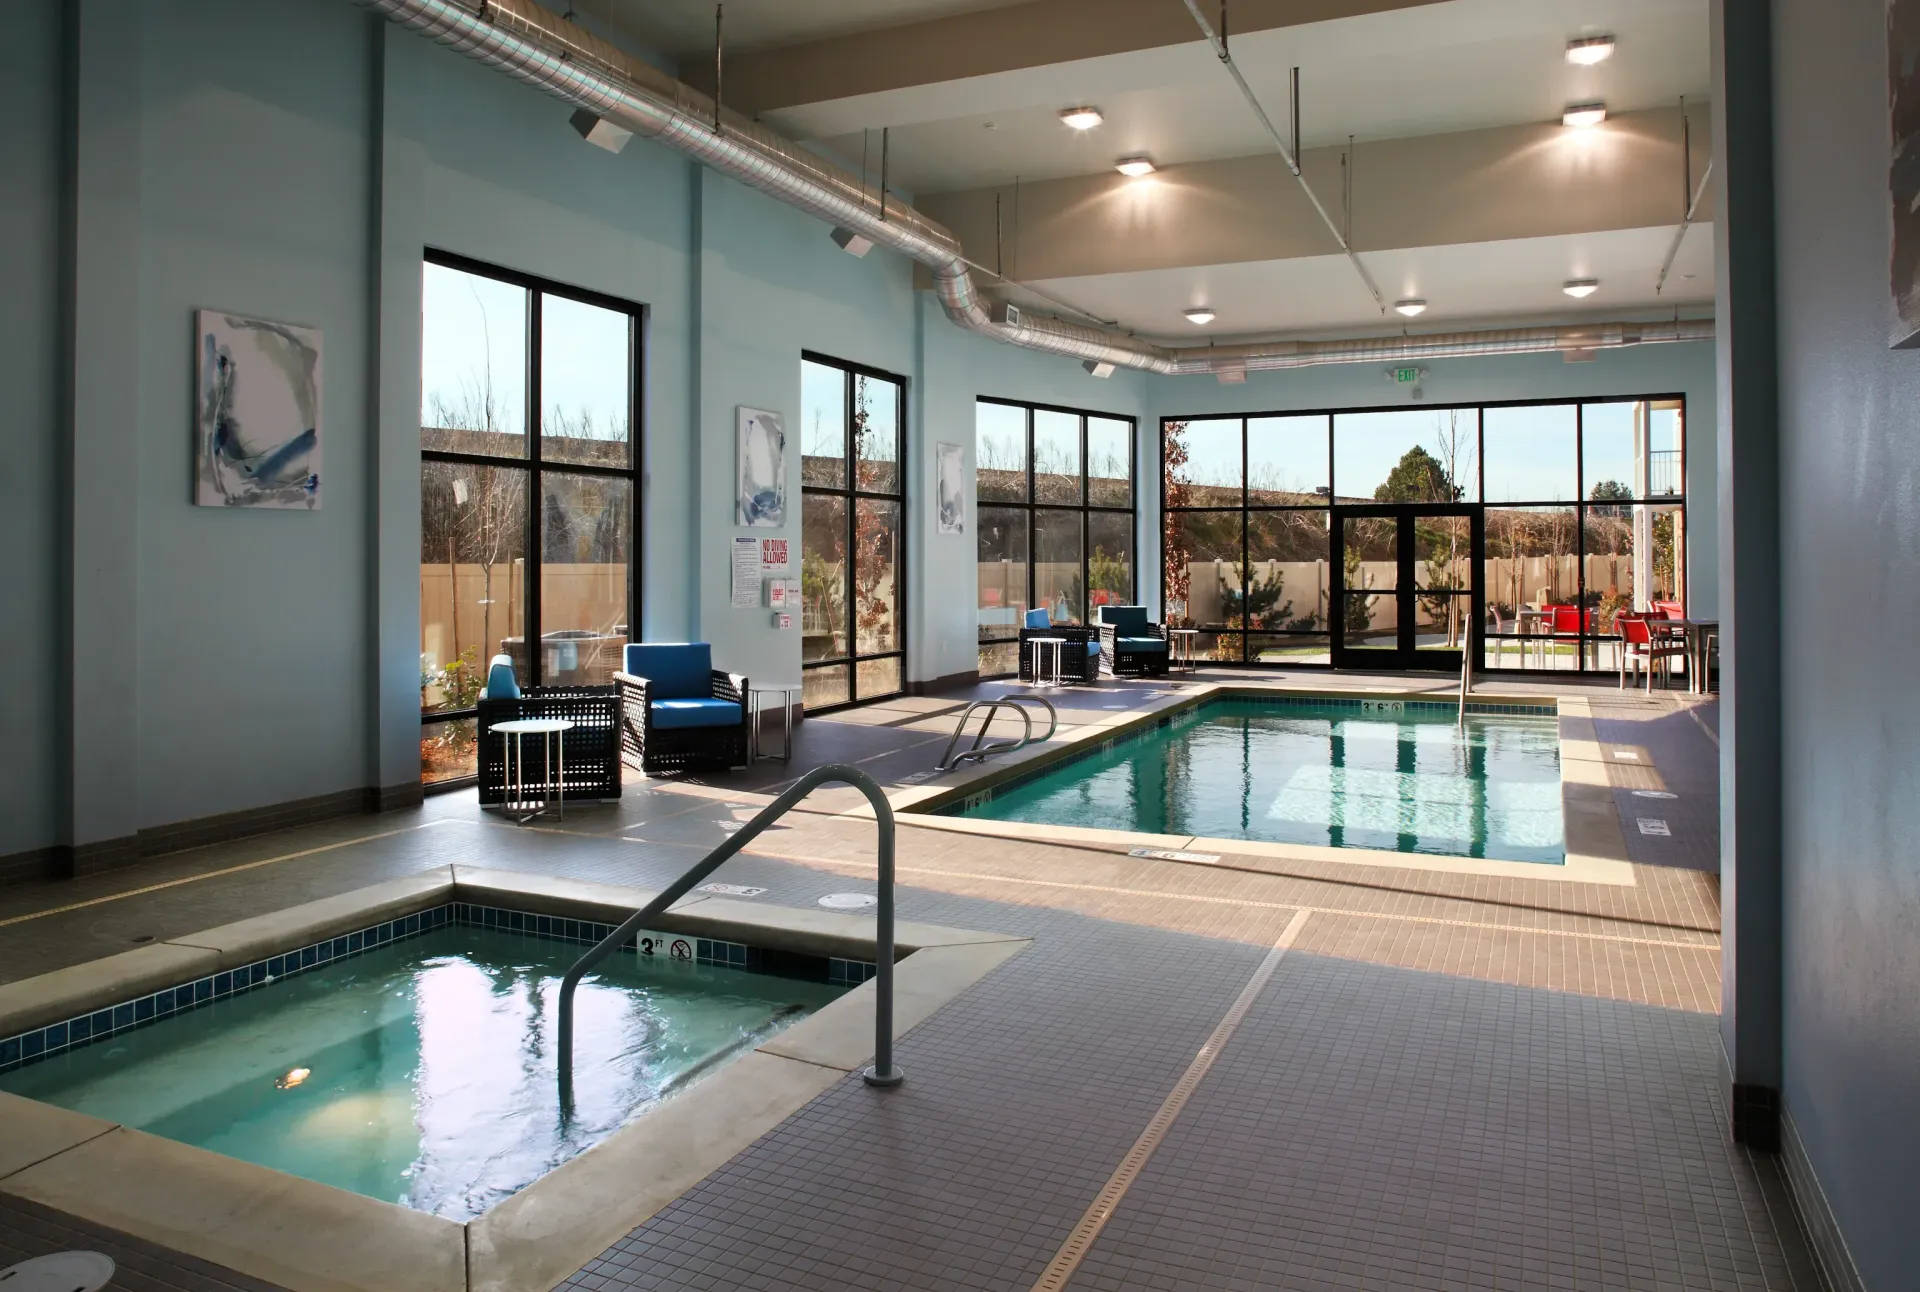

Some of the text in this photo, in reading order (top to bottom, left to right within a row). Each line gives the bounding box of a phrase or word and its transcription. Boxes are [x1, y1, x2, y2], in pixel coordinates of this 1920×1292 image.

[1398, 369, 1416, 382] EXIT
[763, 539, 787, 551] NO DIVING
[763, 552, 787, 564] ALLOWED
[641, 938, 664, 956] 3 FT
